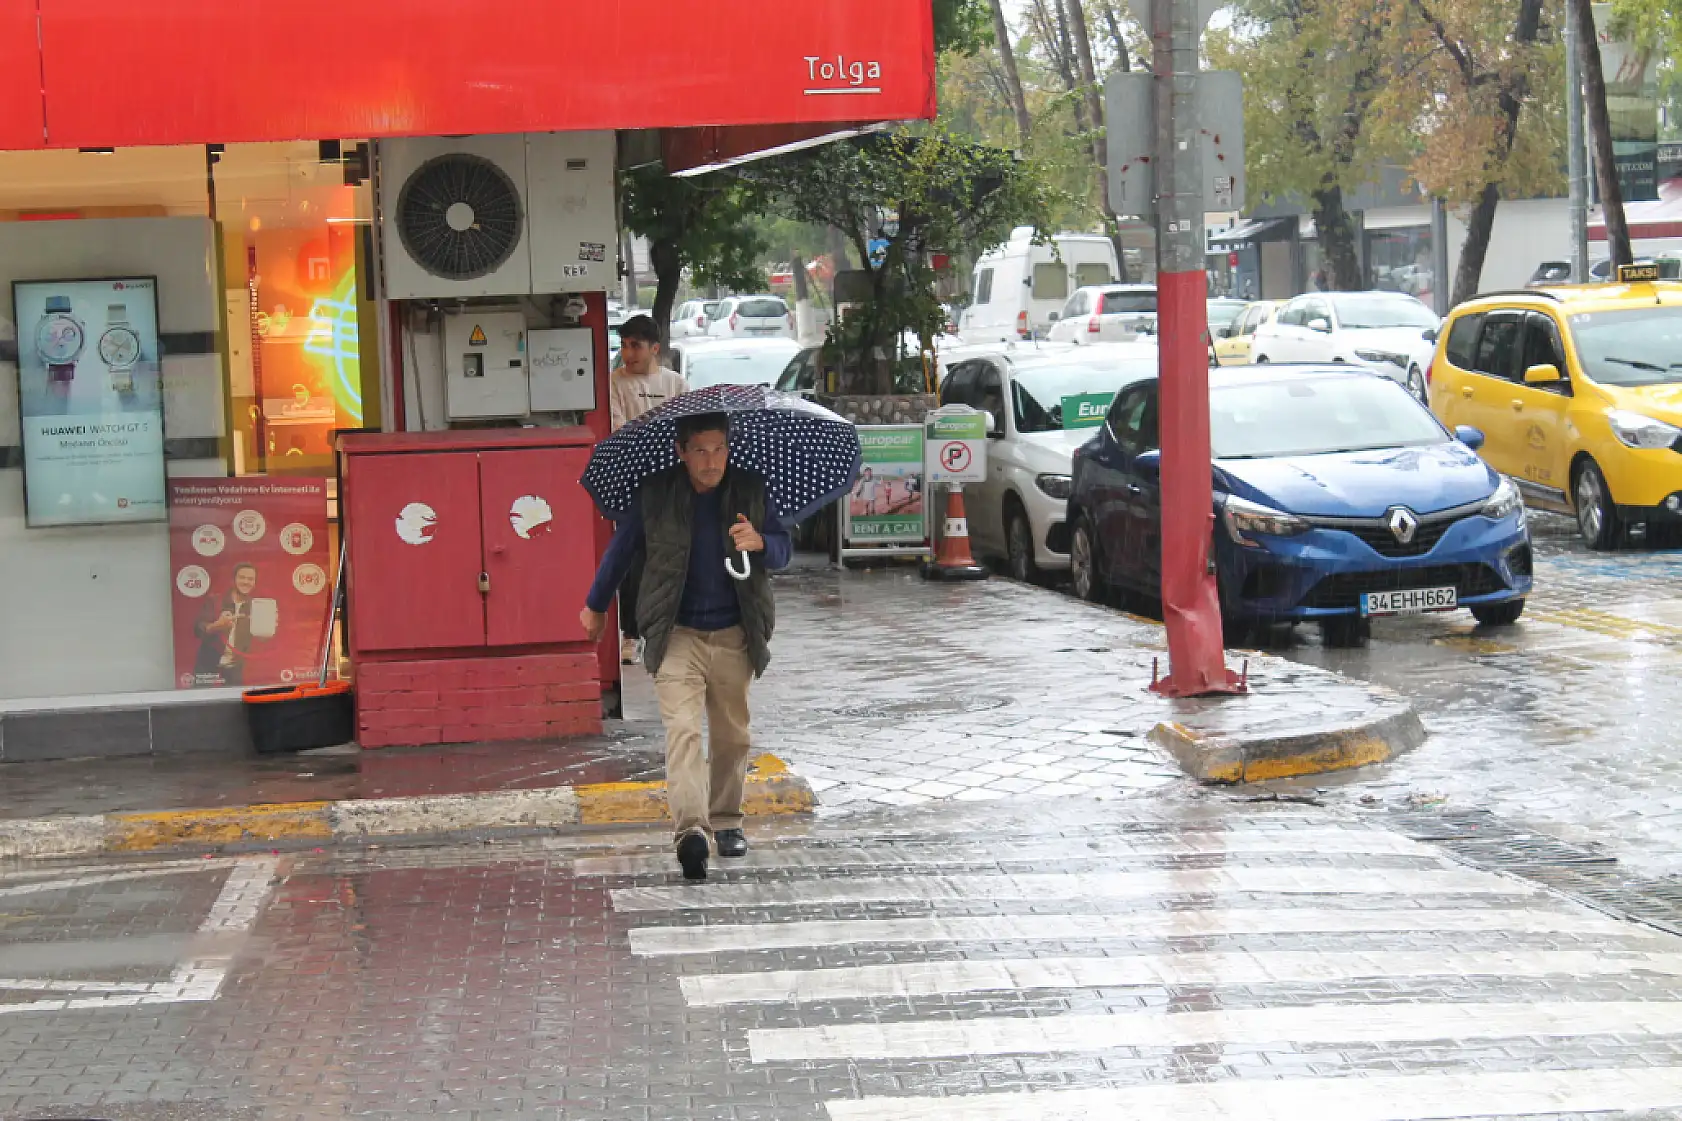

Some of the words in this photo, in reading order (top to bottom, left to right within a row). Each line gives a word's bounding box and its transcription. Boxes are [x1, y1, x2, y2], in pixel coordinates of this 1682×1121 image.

[803, 55, 881, 86] Tolga
[1078, 401, 1109, 416] Eur
[41, 425, 86, 436] HUAWEI
[90, 423, 125, 434] WATCH
[127, 422, 140, 432] GT
[857, 433, 916, 448] Europcar
[854, 523, 879, 534] RENT
[882, 523, 890, 534] A
